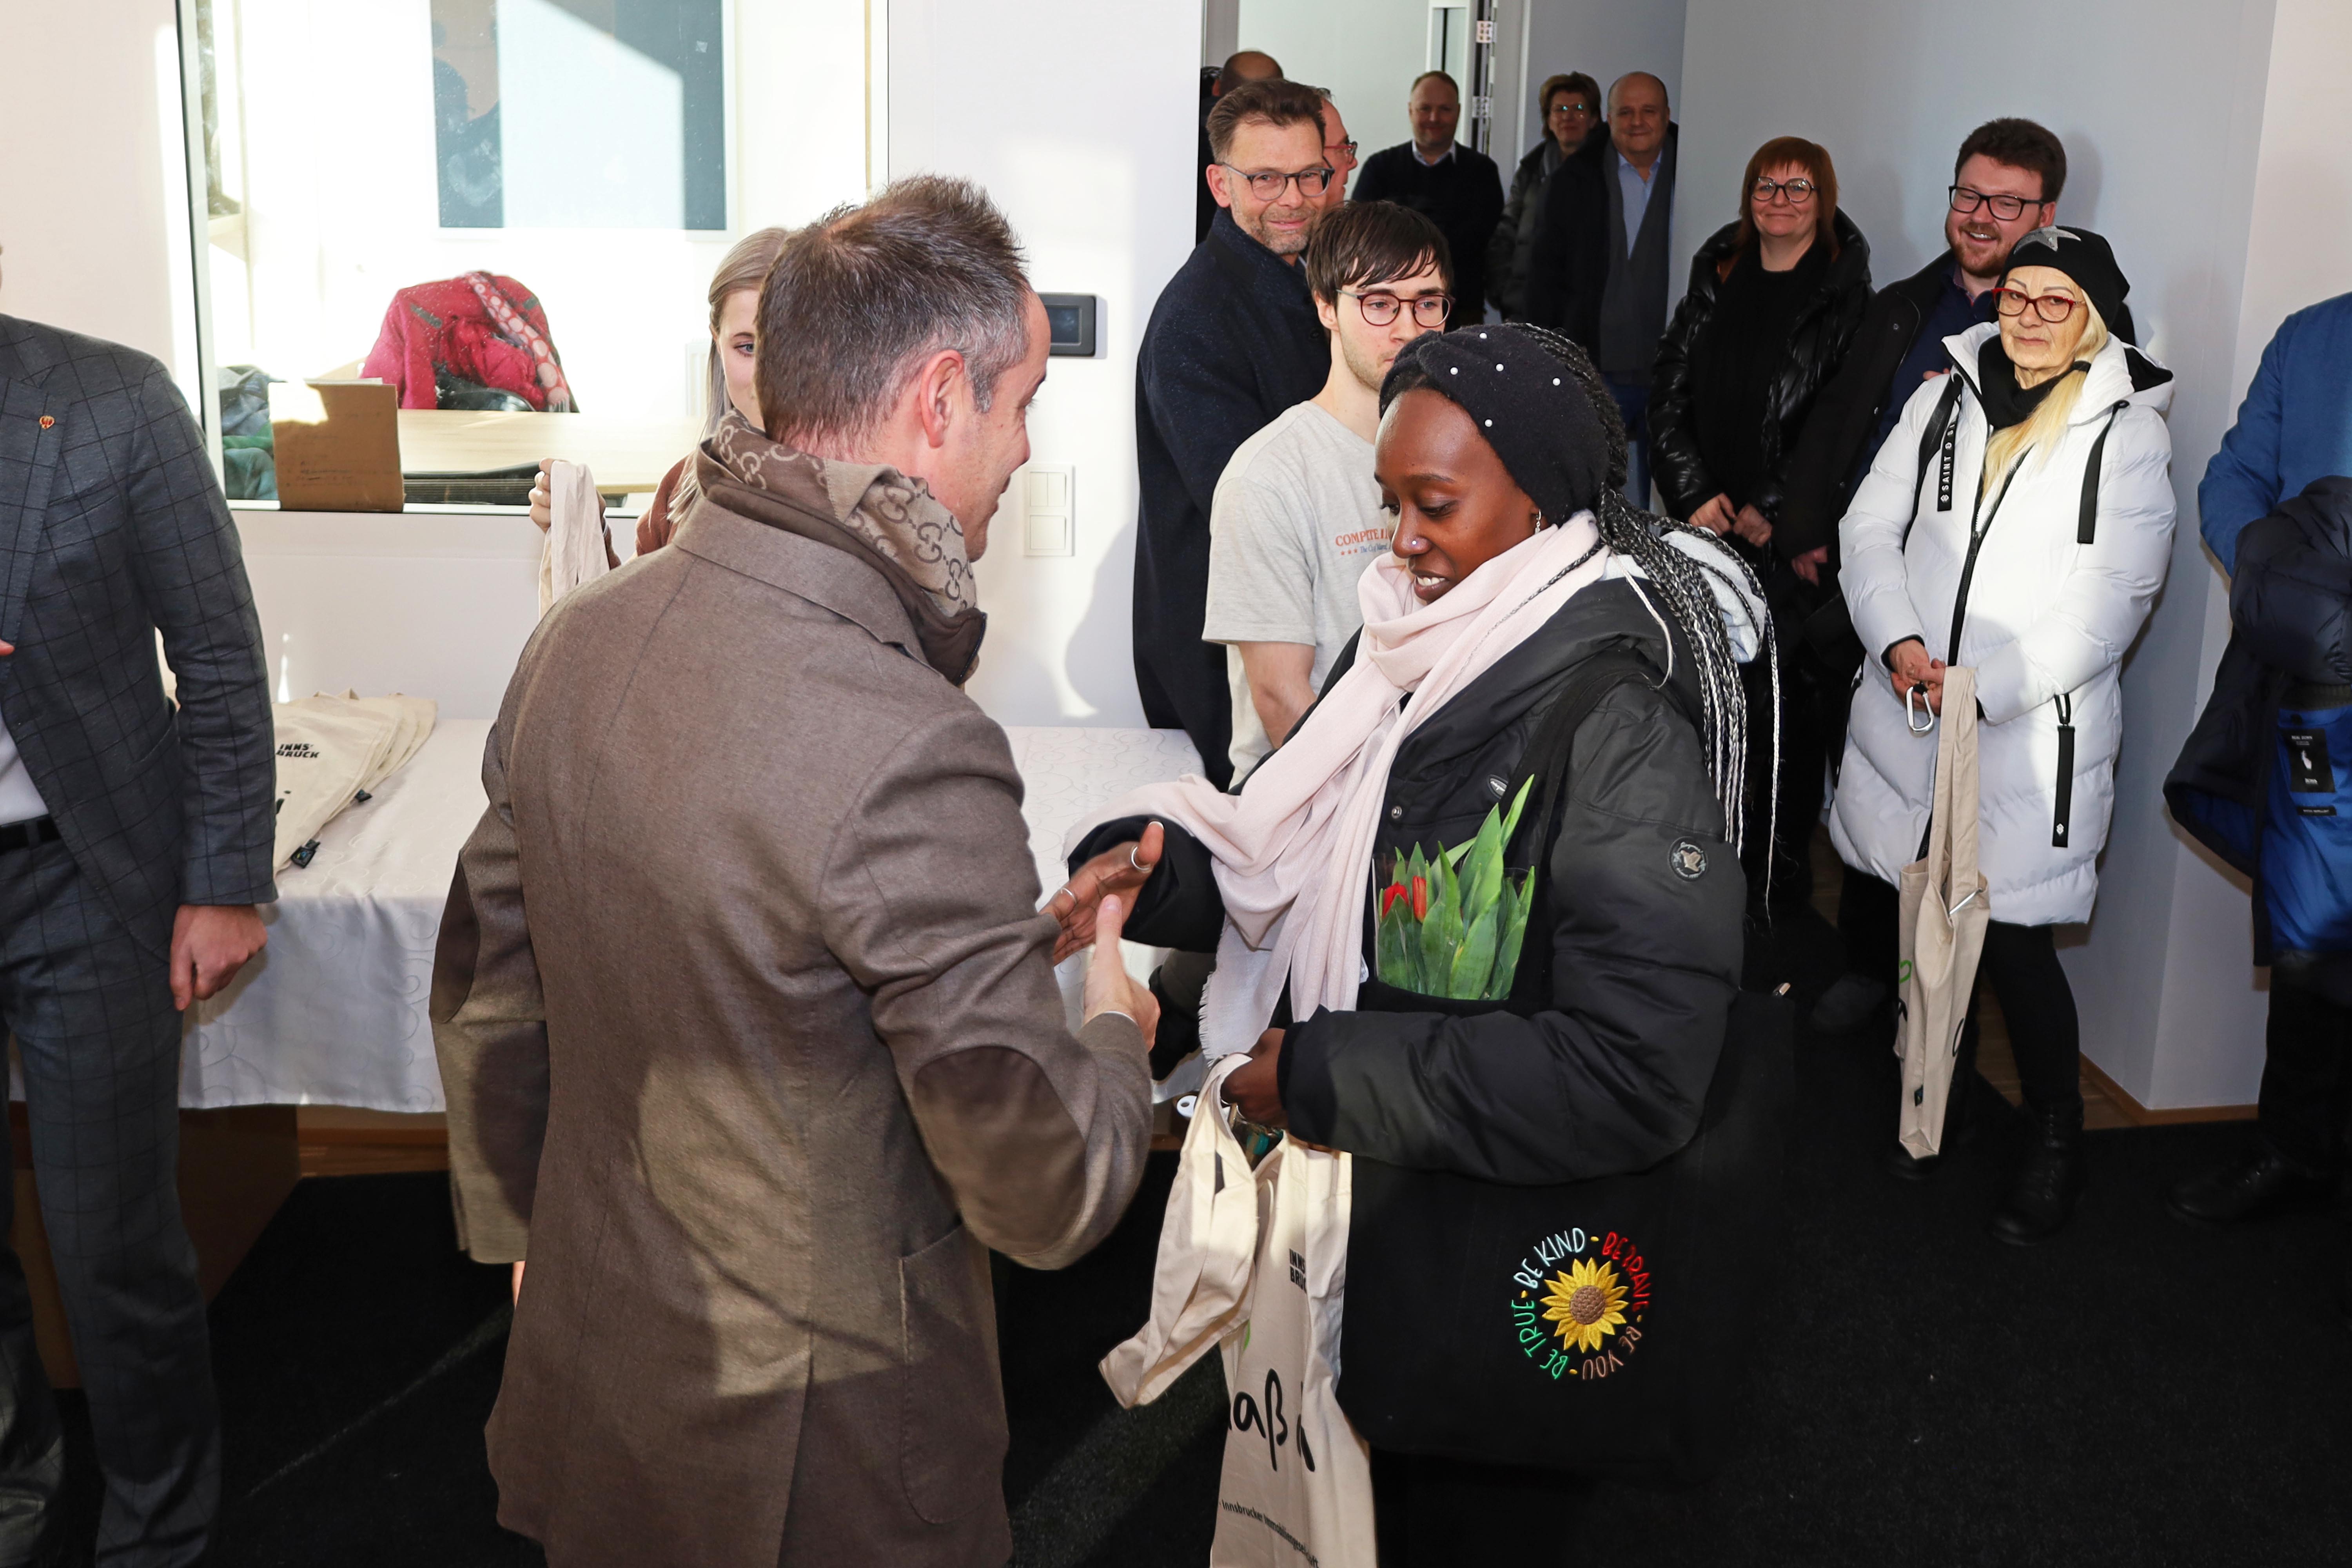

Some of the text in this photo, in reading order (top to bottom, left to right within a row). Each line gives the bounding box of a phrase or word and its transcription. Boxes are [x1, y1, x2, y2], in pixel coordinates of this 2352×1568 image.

[1942, 456, 1951, 491] SAINT
[276, 750, 320, 758] BRUCK
[1514, 1228, 1585, 1289] BE KIND
[1290, 1265, 1307, 1295] BRUC
[1512, 1299, 1568, 1379] BE TRUE
[1583, 1350, 1624, 1379] YOU
[1221, 1499, 1263, 1522] Innsbrucker
